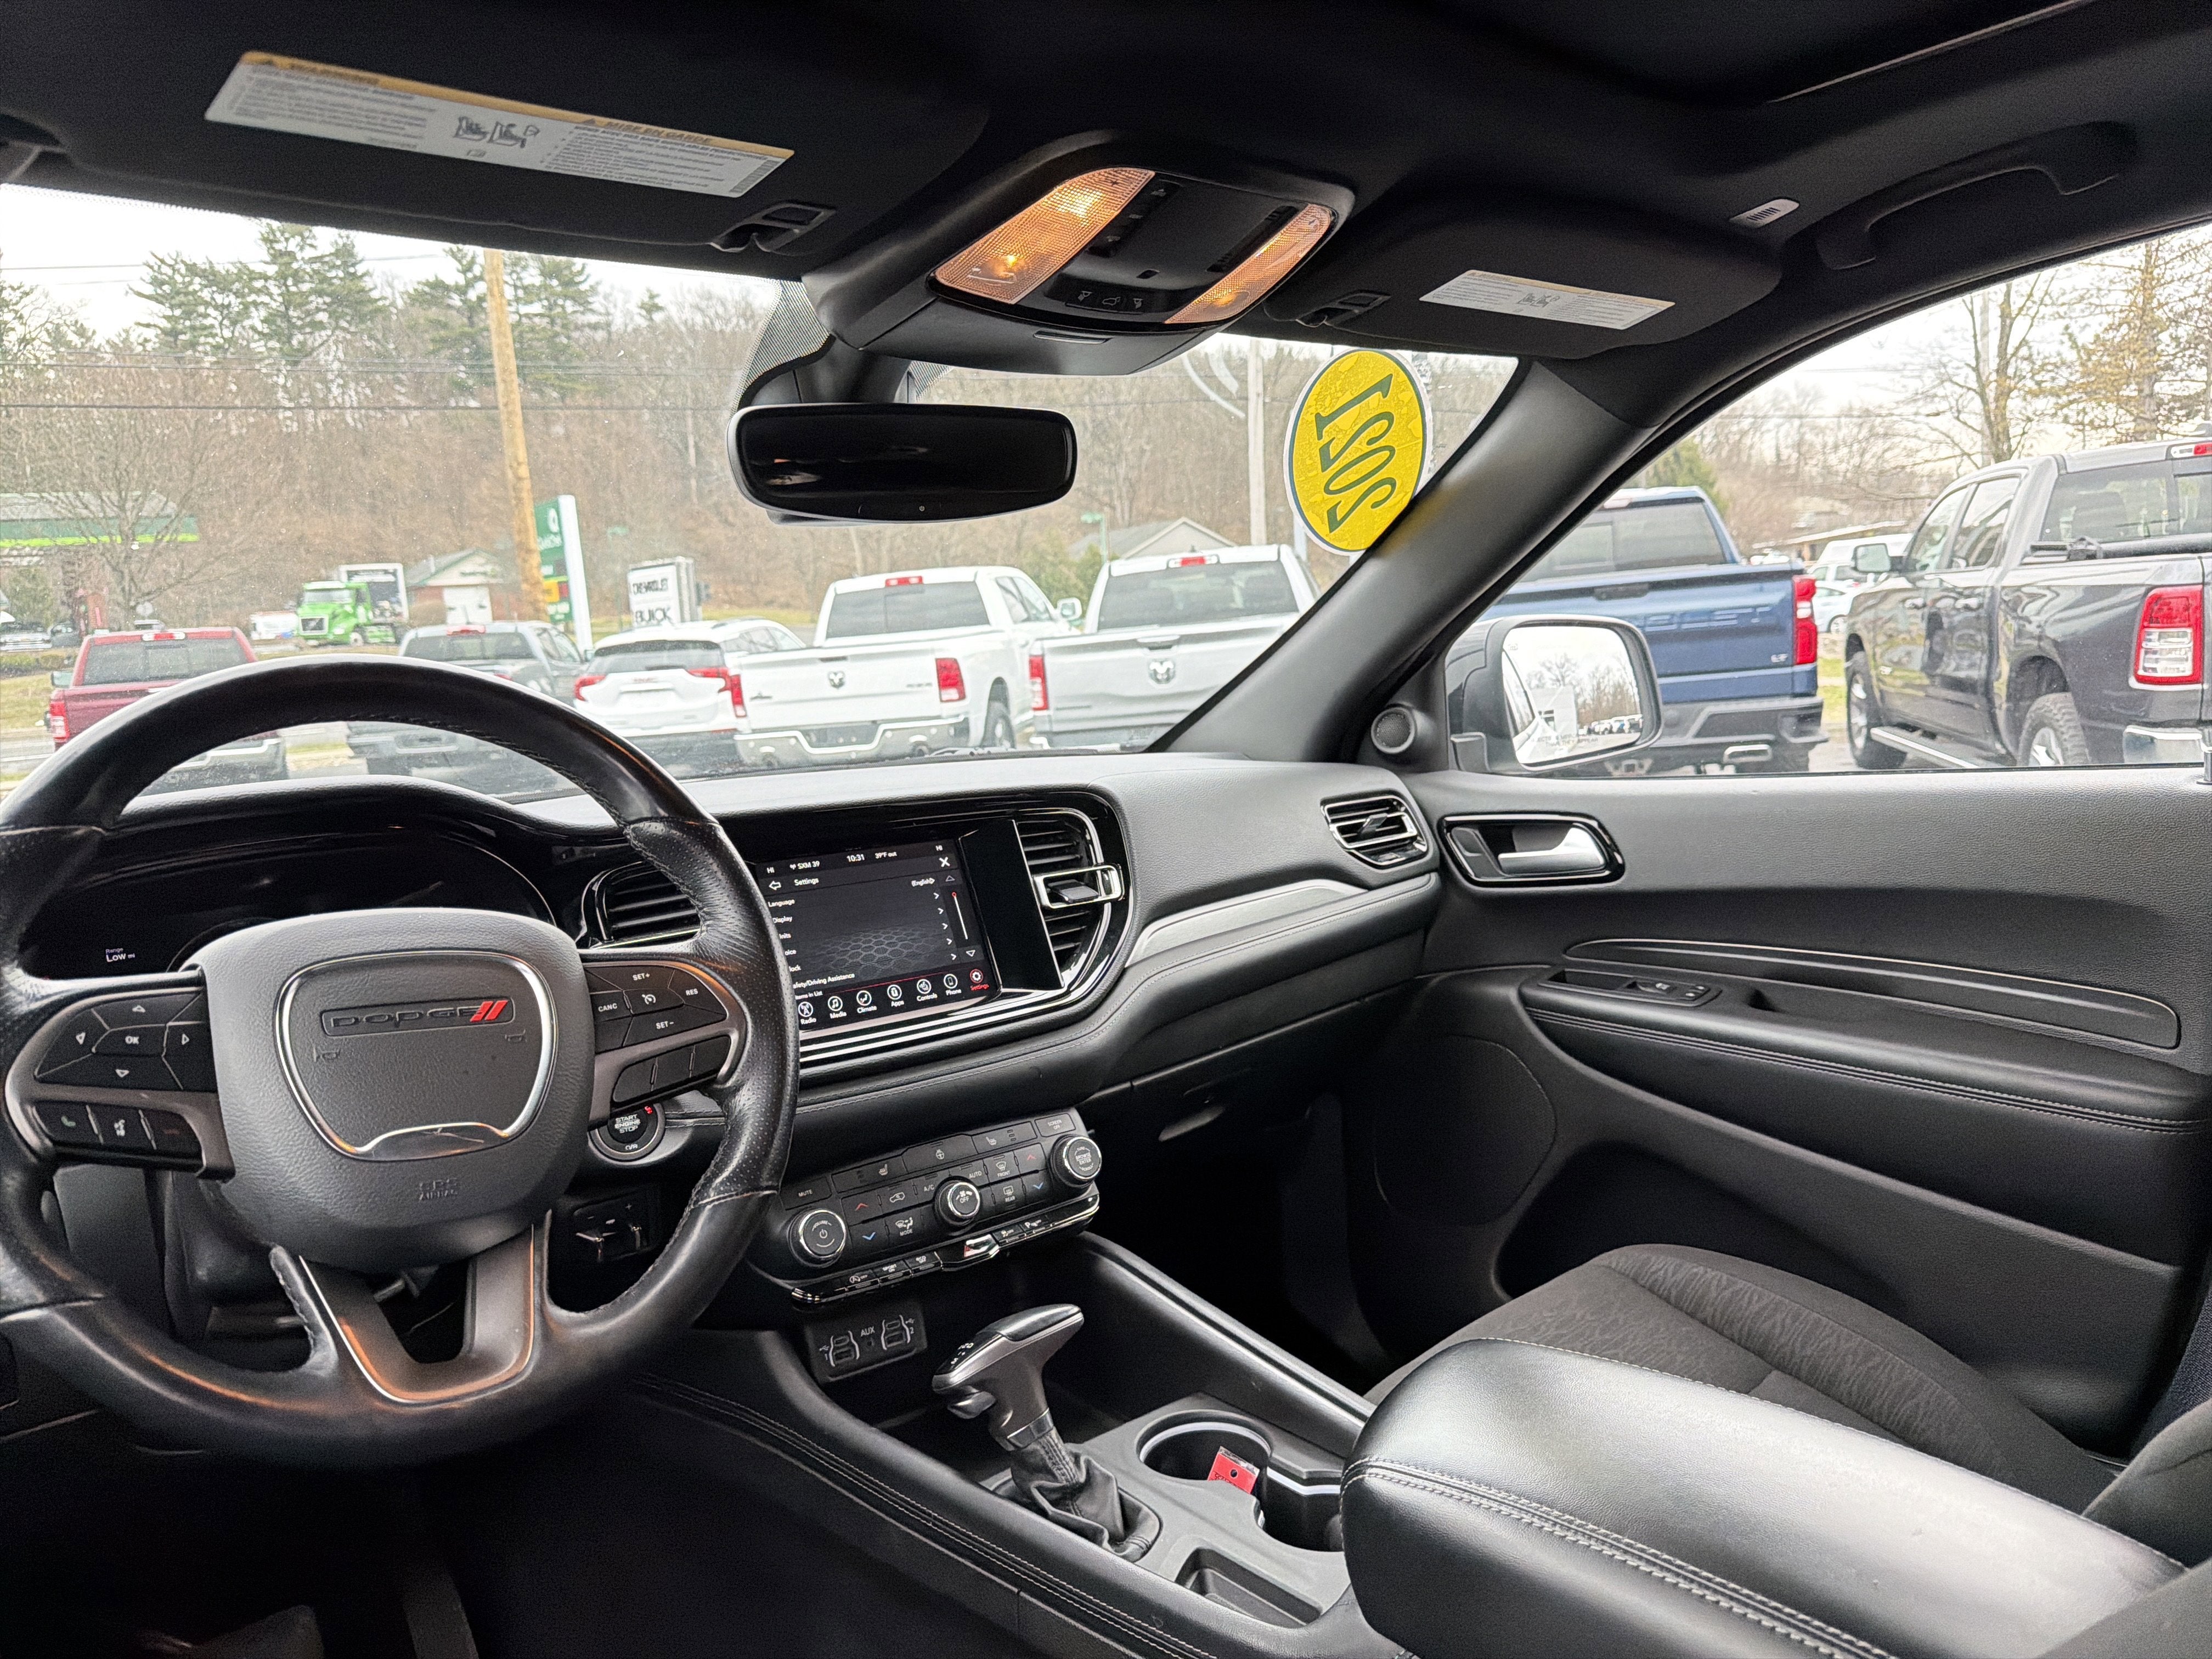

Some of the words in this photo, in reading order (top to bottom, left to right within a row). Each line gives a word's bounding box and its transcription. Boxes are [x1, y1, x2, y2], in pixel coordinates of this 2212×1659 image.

[635, 605, 674, 625] BUICK
[847, 854, 865, 862] 10:31
[794, 878, 819, 886] Settings
[768, 899, 795, 907] Language
[106, 953, 126, 962] LOW
[793, 978, 827, 989] afety/Driving
[827, 973, 855, 983] Assistance
[598, 1003, 618, 1012] CANC
[857, 1005, 877, 1014] Climate
[917, 993, 938, 1002] Controls
[331, 1006, 486, 1028] DODGE
[125, 1035, 139, 1045] OK
[615, 1114, 638, 1124] START
[614, 1119, 641, 1129] ENGINE
[619, 1125, 638, 1134] STOP
[969, 1170, 982, 1178] AUTO
[814, 1220, 828, 1229] VOLUME
[861, 1326, 876, 1336] AUX
